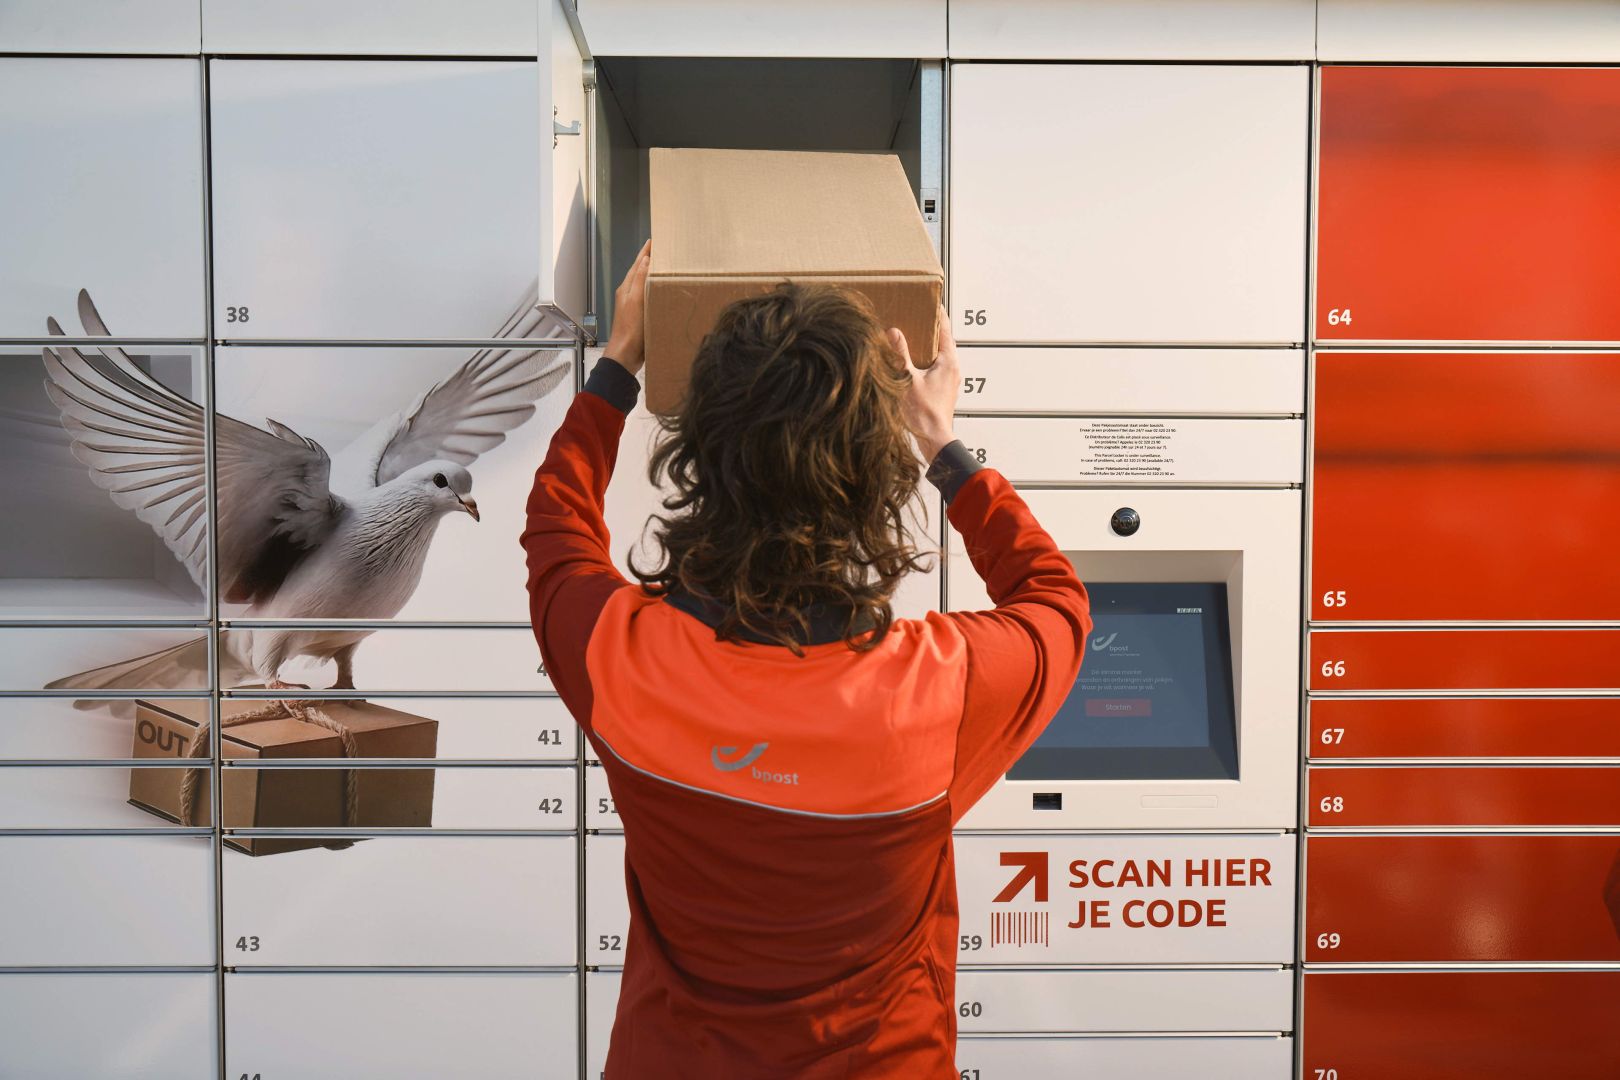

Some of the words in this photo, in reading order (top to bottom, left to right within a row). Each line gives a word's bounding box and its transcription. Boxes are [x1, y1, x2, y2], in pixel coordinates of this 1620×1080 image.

[226, 306, 250, 323] 38
[964, 309, 987, 326] 56
[1327, 308, 1352, 326] 64
[963, 377, 987, 394] 57
[1323, 590, 1347, 608] 65
[1109, 645, 1128, 653] bpost
[1321, 660, 1346, 677] 66
[138, 720, 189, 758] OUT
[537, 729, 562, 746] 41
[1321, 728, 1345, 745] 67
[752, 766, 800, 785] bpost
[538, 797, 563, 814] 42
[1320, 796, 1344, 813] 68
[1068, 859, 1172, 888] SCAN
[1185, 858, 1272, 887] HIER
[1067, 900, 1111, 929] JE
[1122, 899, 1227, 929] CODE
[235, 935, 260, 952] 43
[599, 935, 622, 951] 52
[960, 935, 982, 951] 59
[1317, 932, 1341, 949] 69
[959, 1001, 983, 1018] 60
[1314, 1068, 1338, 1080] 70
